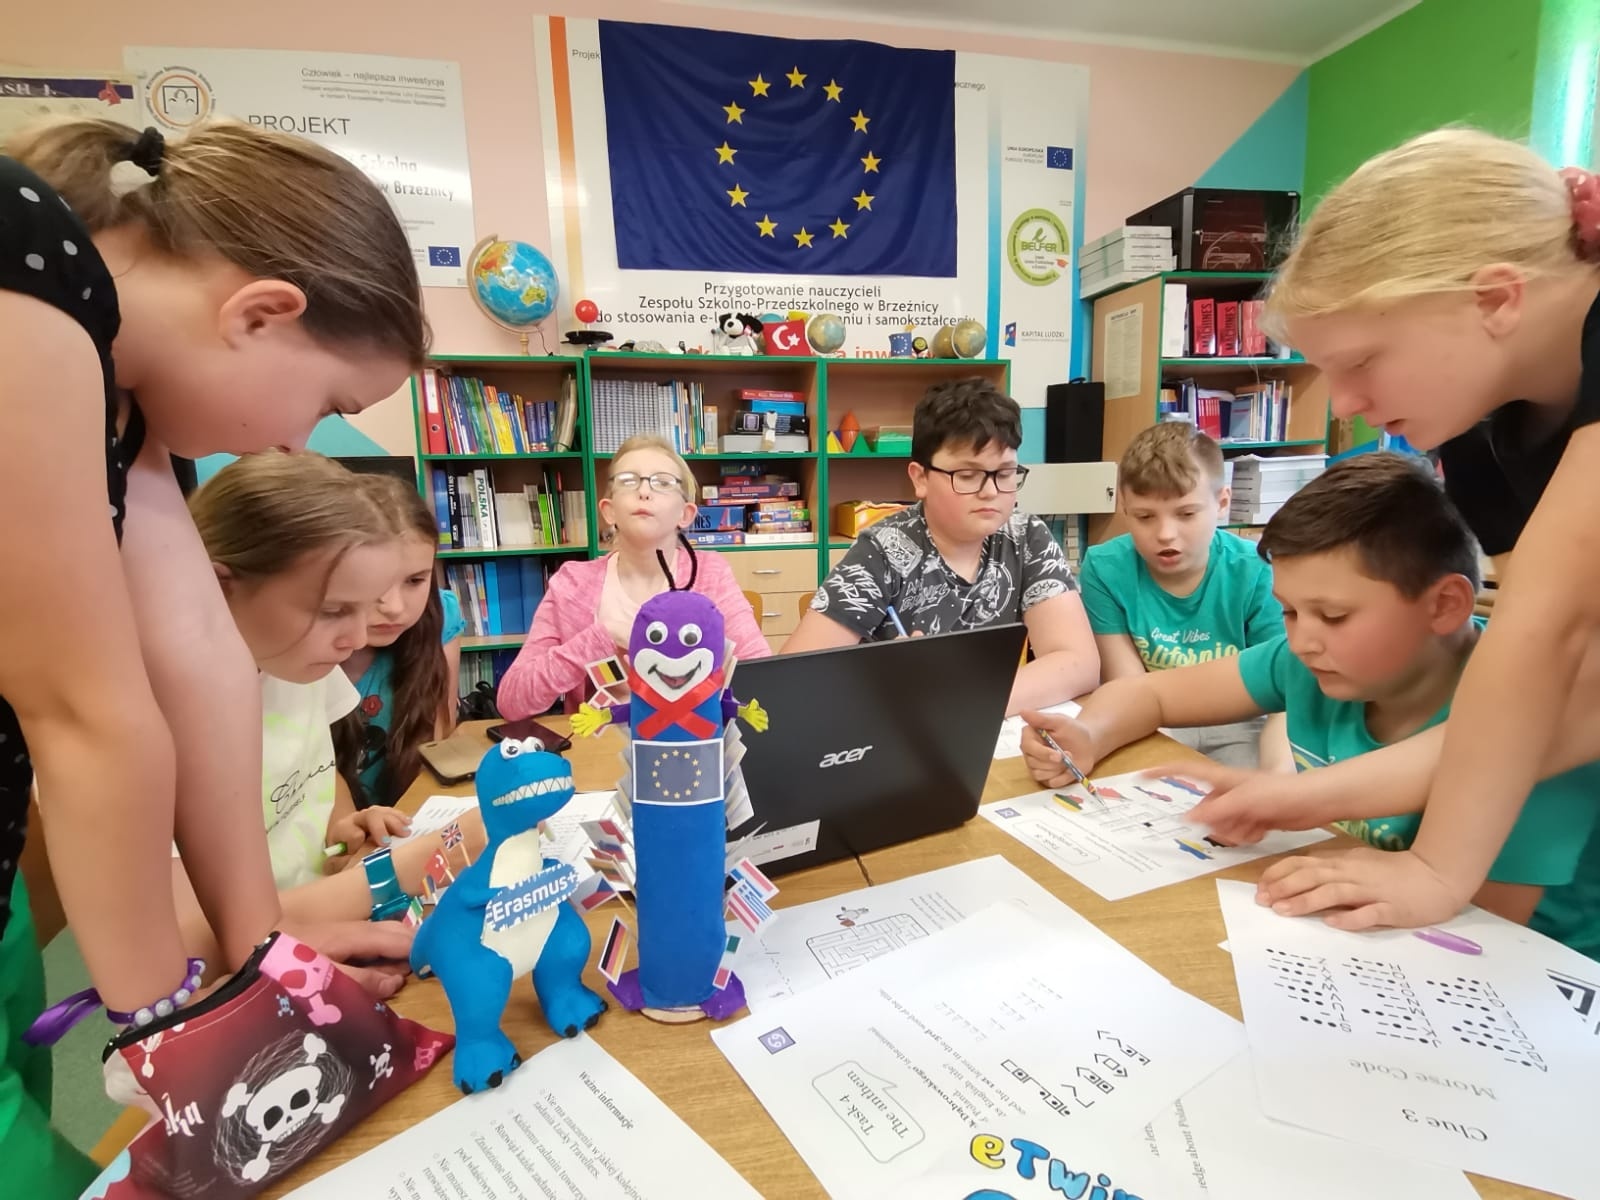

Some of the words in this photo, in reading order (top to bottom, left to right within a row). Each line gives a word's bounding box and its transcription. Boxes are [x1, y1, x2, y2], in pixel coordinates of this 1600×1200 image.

[571, 48, 601, 61] Projek
[249, 114, 350, 135] PROJEKT
[1021, 241, 1057, 252] BELFER
[704, 282, 804, 298] Przygotowanie
[809, 285, 881, 299] nauczycieli
[639, 296, 693, 311] Zespołu
[698, 297, 859, 313] Szkolno-Przedszkolnego
[864, 303, 874, 311] w
[617, 312, 695, 324] stosowania
[475, 477, 488, 518] POLSKA
[1151, 626, 1181, 644] Great
[1182, 629, 1211, 644] Vibes
[819, 745, 873, 768] acer
[491, 871, 579, 923] Erasmus+
[1348, 1059, 1408, 1081] Code
[847, 1070, 887, 1112] anthem
[1415, 1072, 1497, 1100] Morse
[840, 1094, 850, 1103] 4
[847, 1104, 875, 1136] Task
[886, 1112, 909, 1139] The
[1402, 1108, 1418, 1123] 3
[1426, 1117, 1488, 1142] Clue
[1182, 1130, 1198, 1160] about
